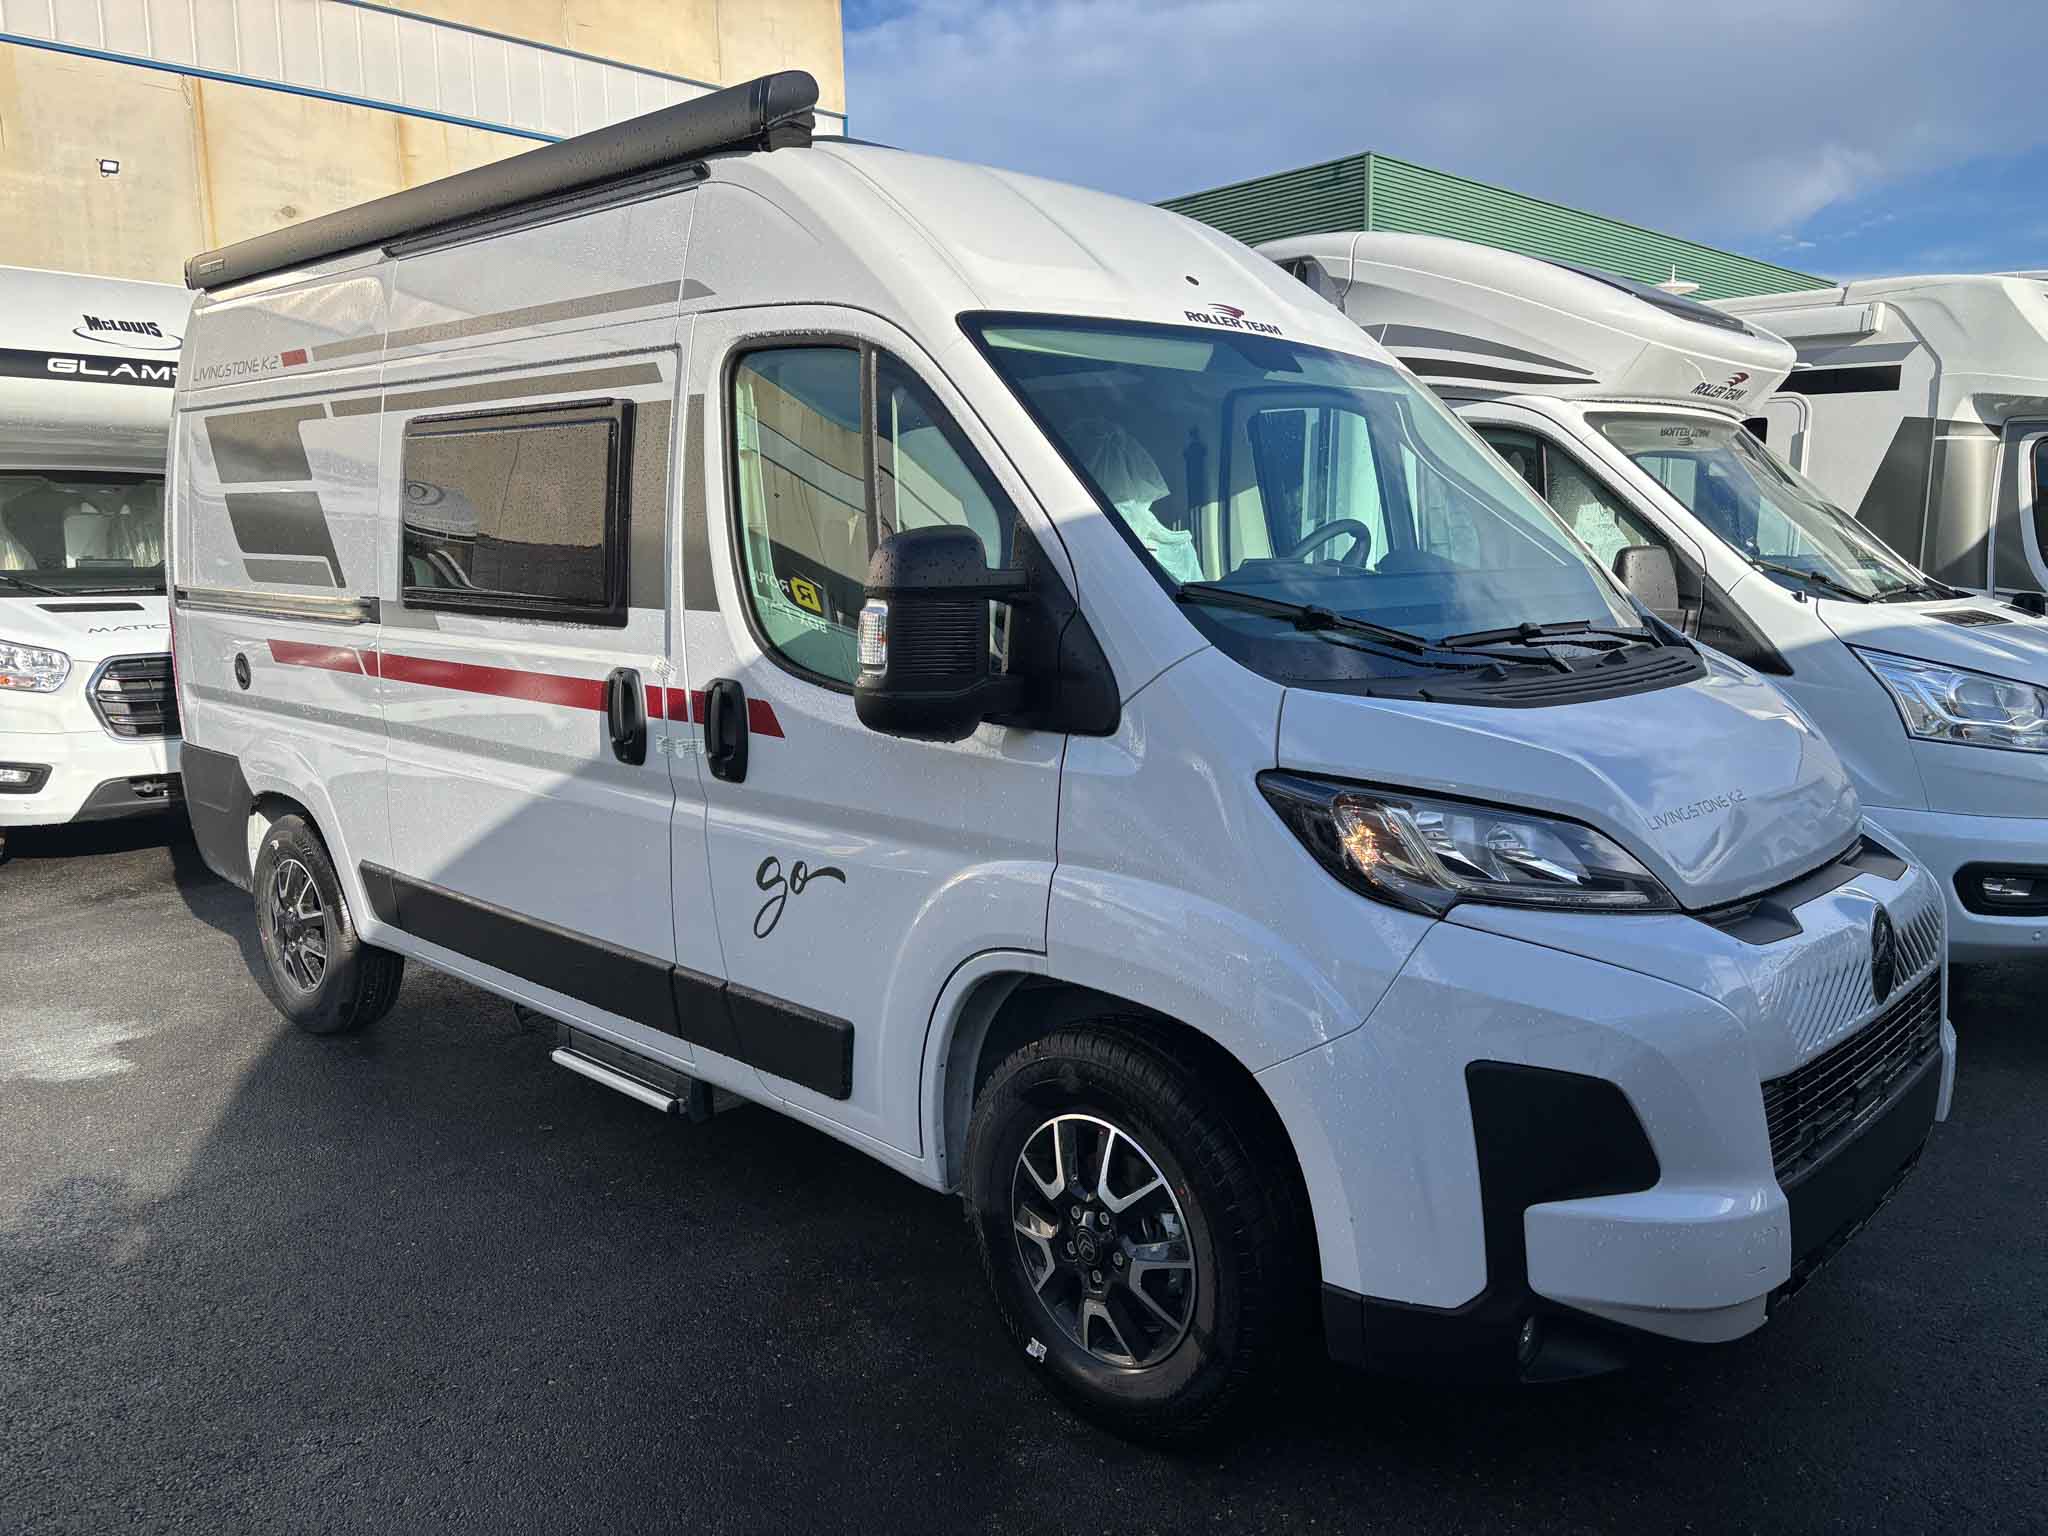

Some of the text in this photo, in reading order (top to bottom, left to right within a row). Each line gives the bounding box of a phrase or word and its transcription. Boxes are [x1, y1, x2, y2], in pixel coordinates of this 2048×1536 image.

[1184, 310, 1283, 336] ROLLER TEAM
[193, 355, 279, 382] LIVINGSTONE K2
[1690, 382, 1748, 401] ROLLER TEAM
[88, 623, 169, 633] MATIC
[1646, 789, 1747, 830] LIVINGSTONE K2
[753, 856, 847, 939] go
